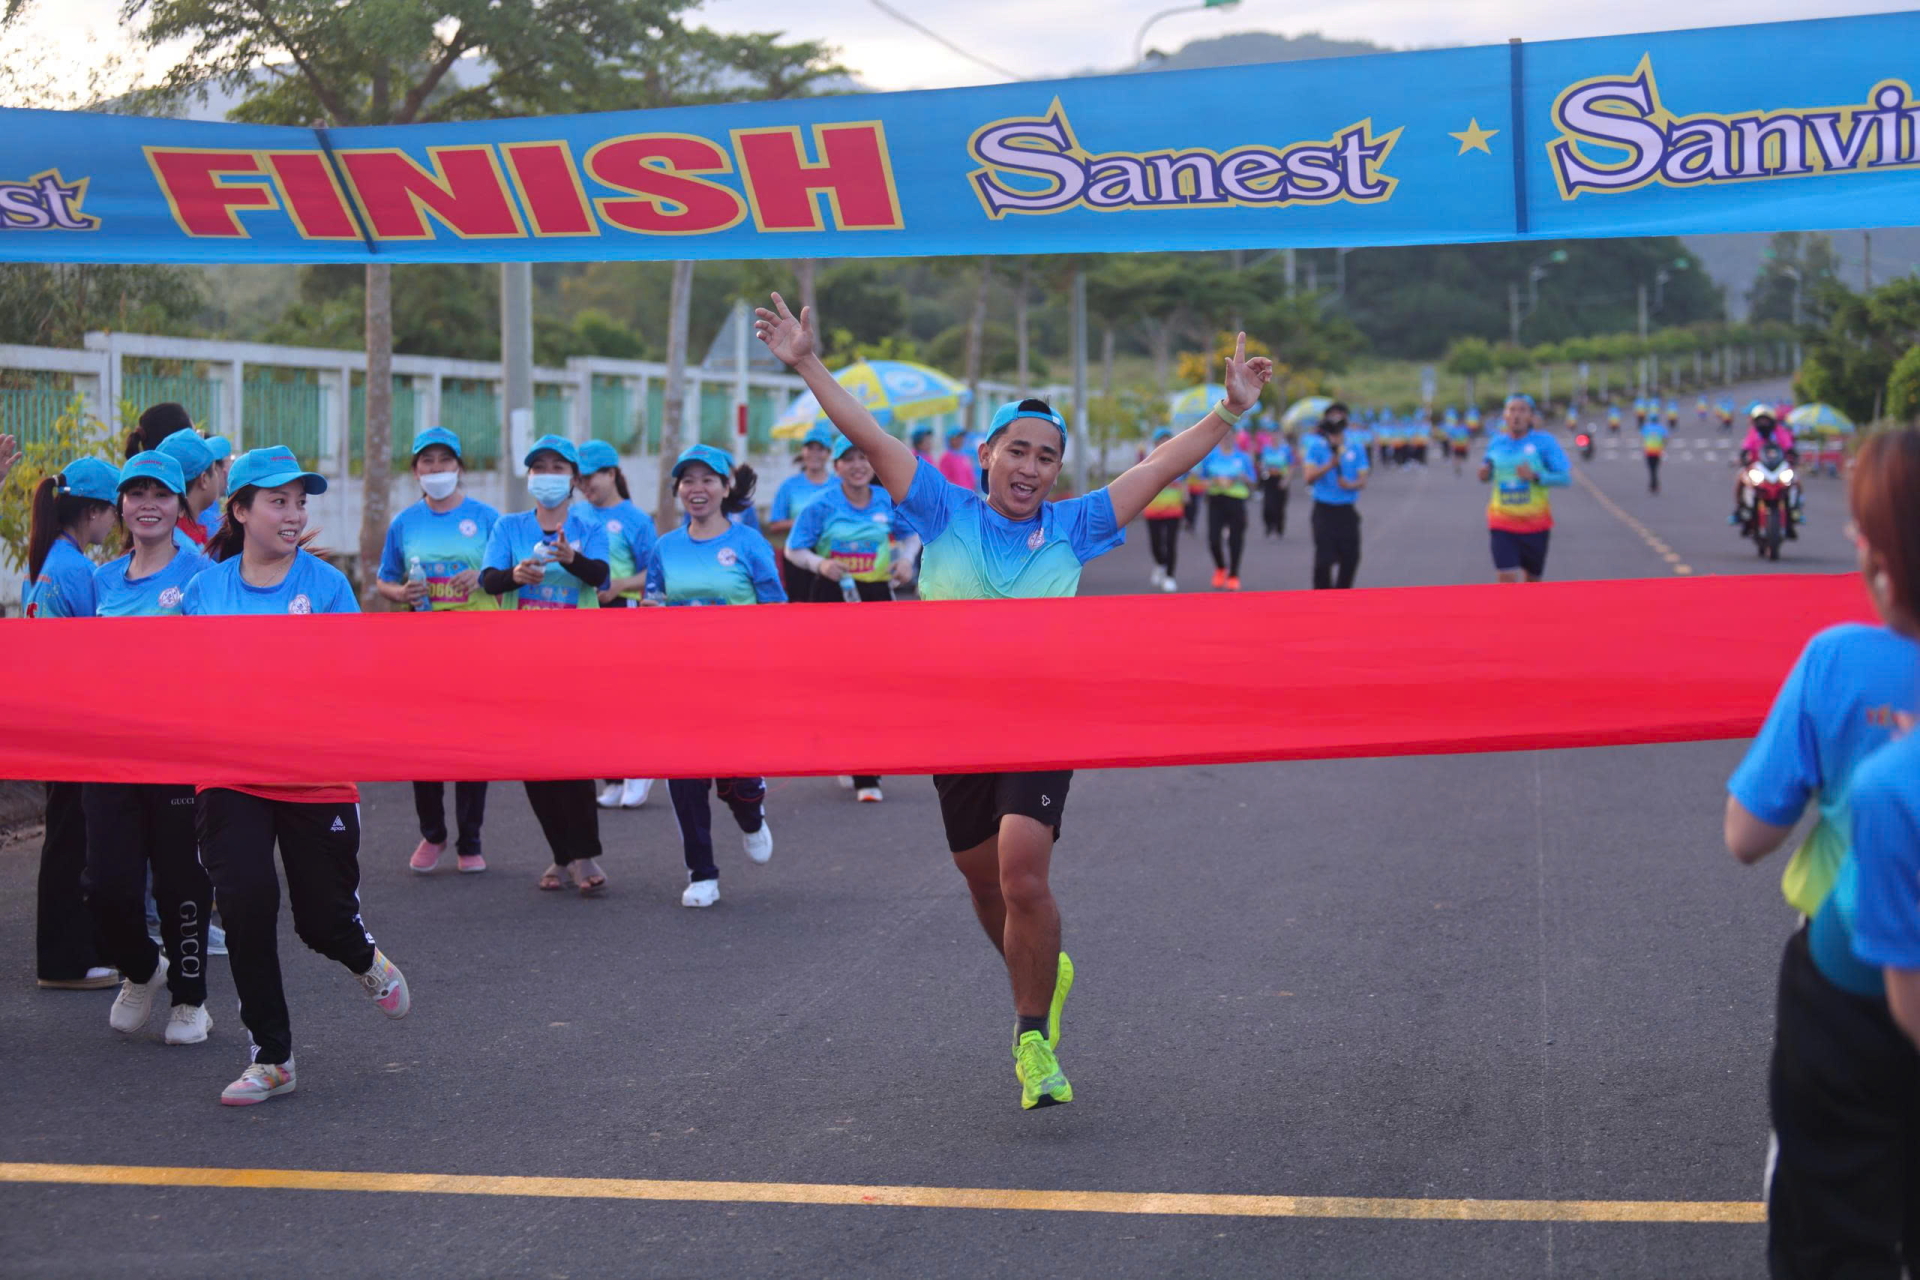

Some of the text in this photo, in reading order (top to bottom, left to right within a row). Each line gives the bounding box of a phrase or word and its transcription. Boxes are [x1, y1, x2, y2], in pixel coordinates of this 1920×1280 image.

[142, 118, 905, 241] FINISH
[966, 94, 1404, 221] Sanest
[1545, 52, 1920, 200] Sanvi
[171, 797, 195, 806] GUCCI
[179, 900, 201, 978] GUCCI
